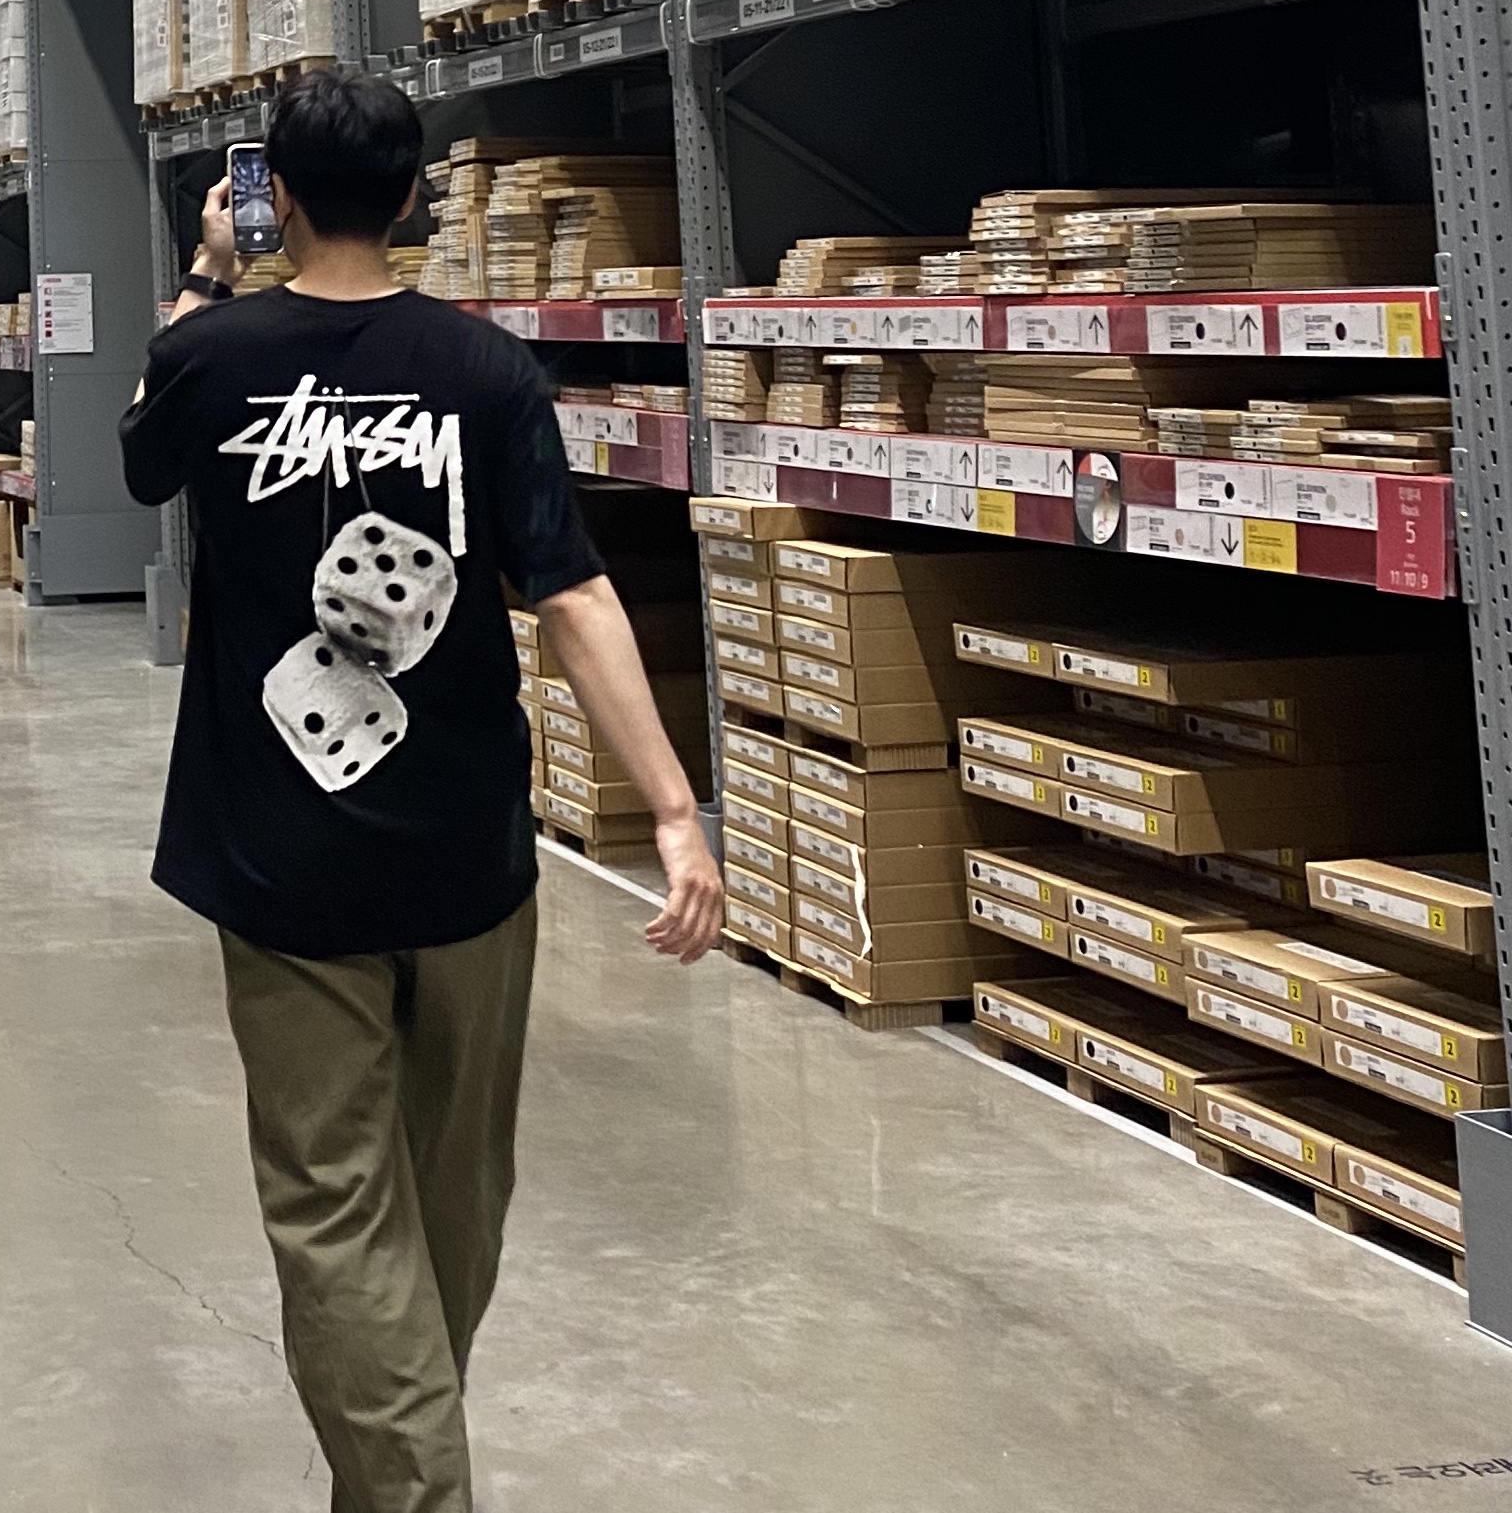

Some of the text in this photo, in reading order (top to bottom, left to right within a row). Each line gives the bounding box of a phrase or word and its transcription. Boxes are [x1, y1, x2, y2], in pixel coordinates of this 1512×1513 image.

[1405, 520, 1416, 544] 5
[1390, 570, 1429, 589] 11 10 9
[1349, 1468, 1393, 1486] 곳
